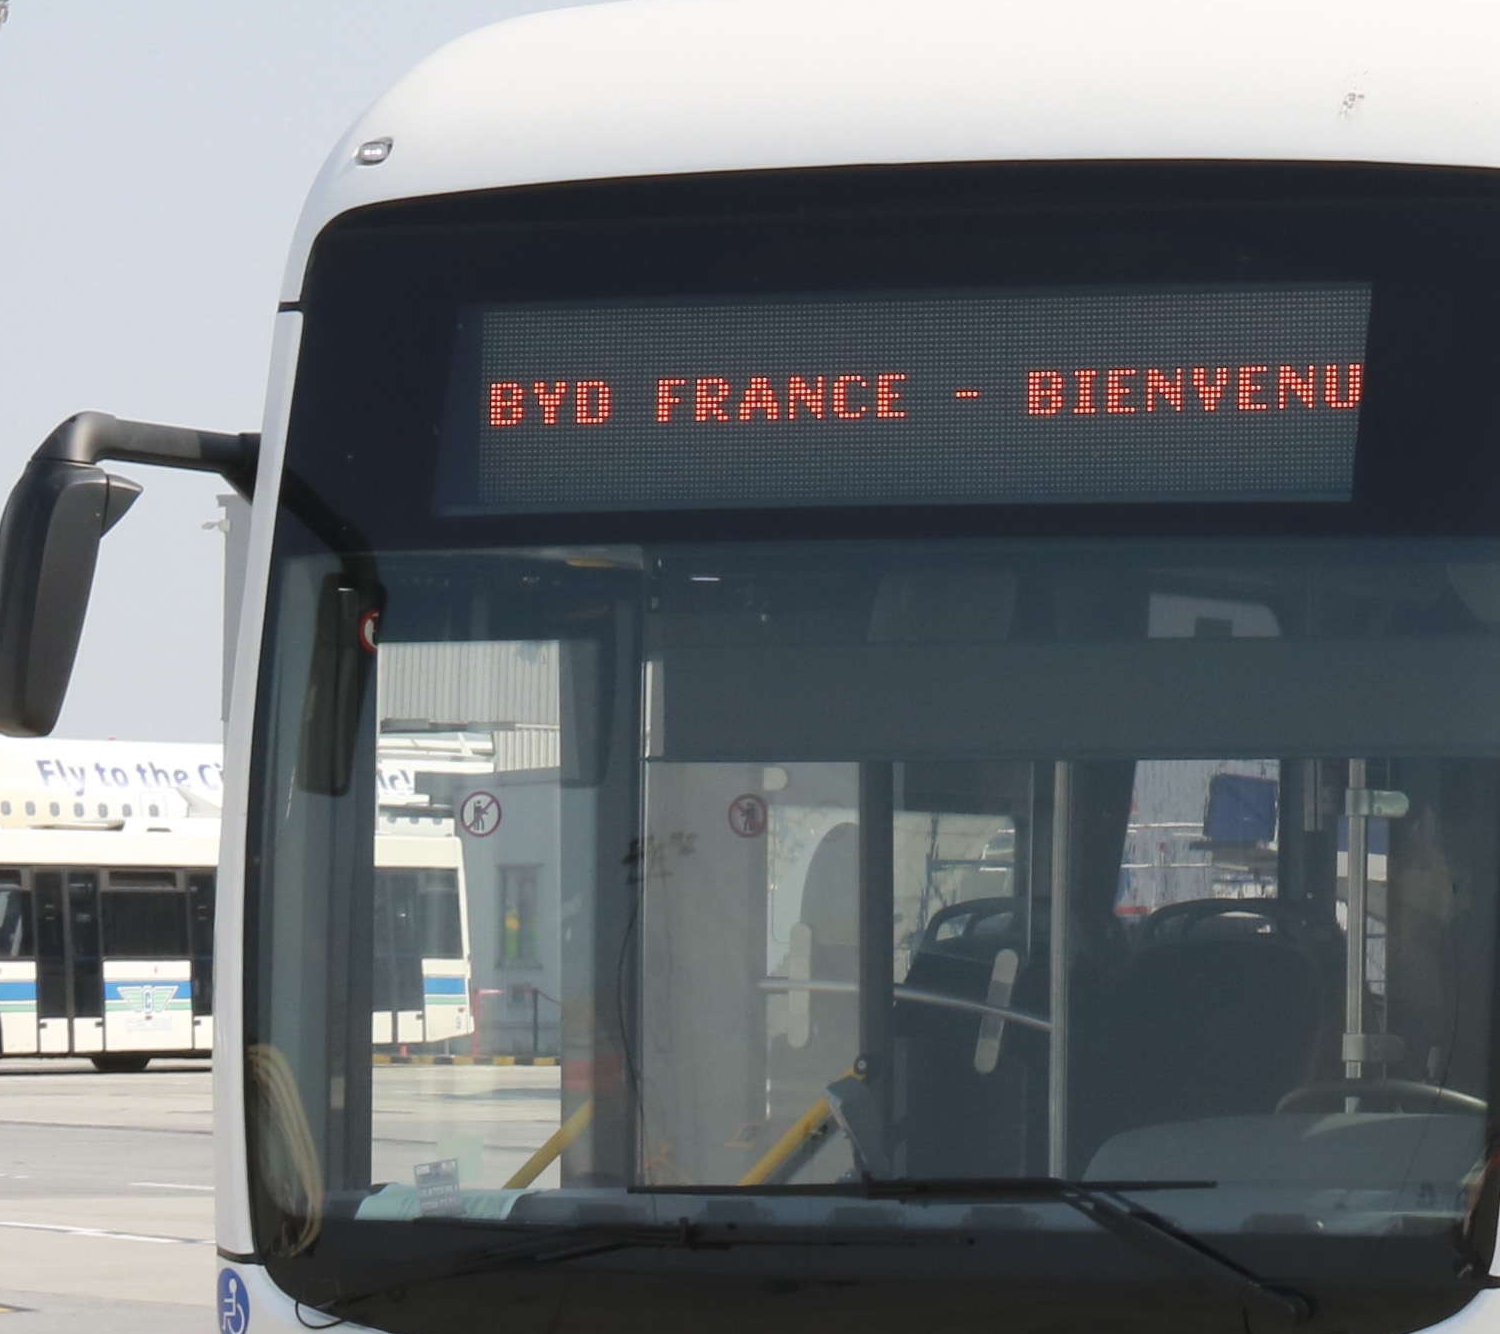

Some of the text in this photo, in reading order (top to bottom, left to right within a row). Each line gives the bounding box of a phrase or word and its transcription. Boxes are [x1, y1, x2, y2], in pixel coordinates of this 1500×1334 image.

[489, 380, 610, 425] BYD
[656, 373, 906, 422] FRANCE
[1027, 363, 1361, 415] BIENVENU
[36, 759, 86, 797] Fly
[95, 763, 129, 788] to
[136, 762, 191, 789] the
